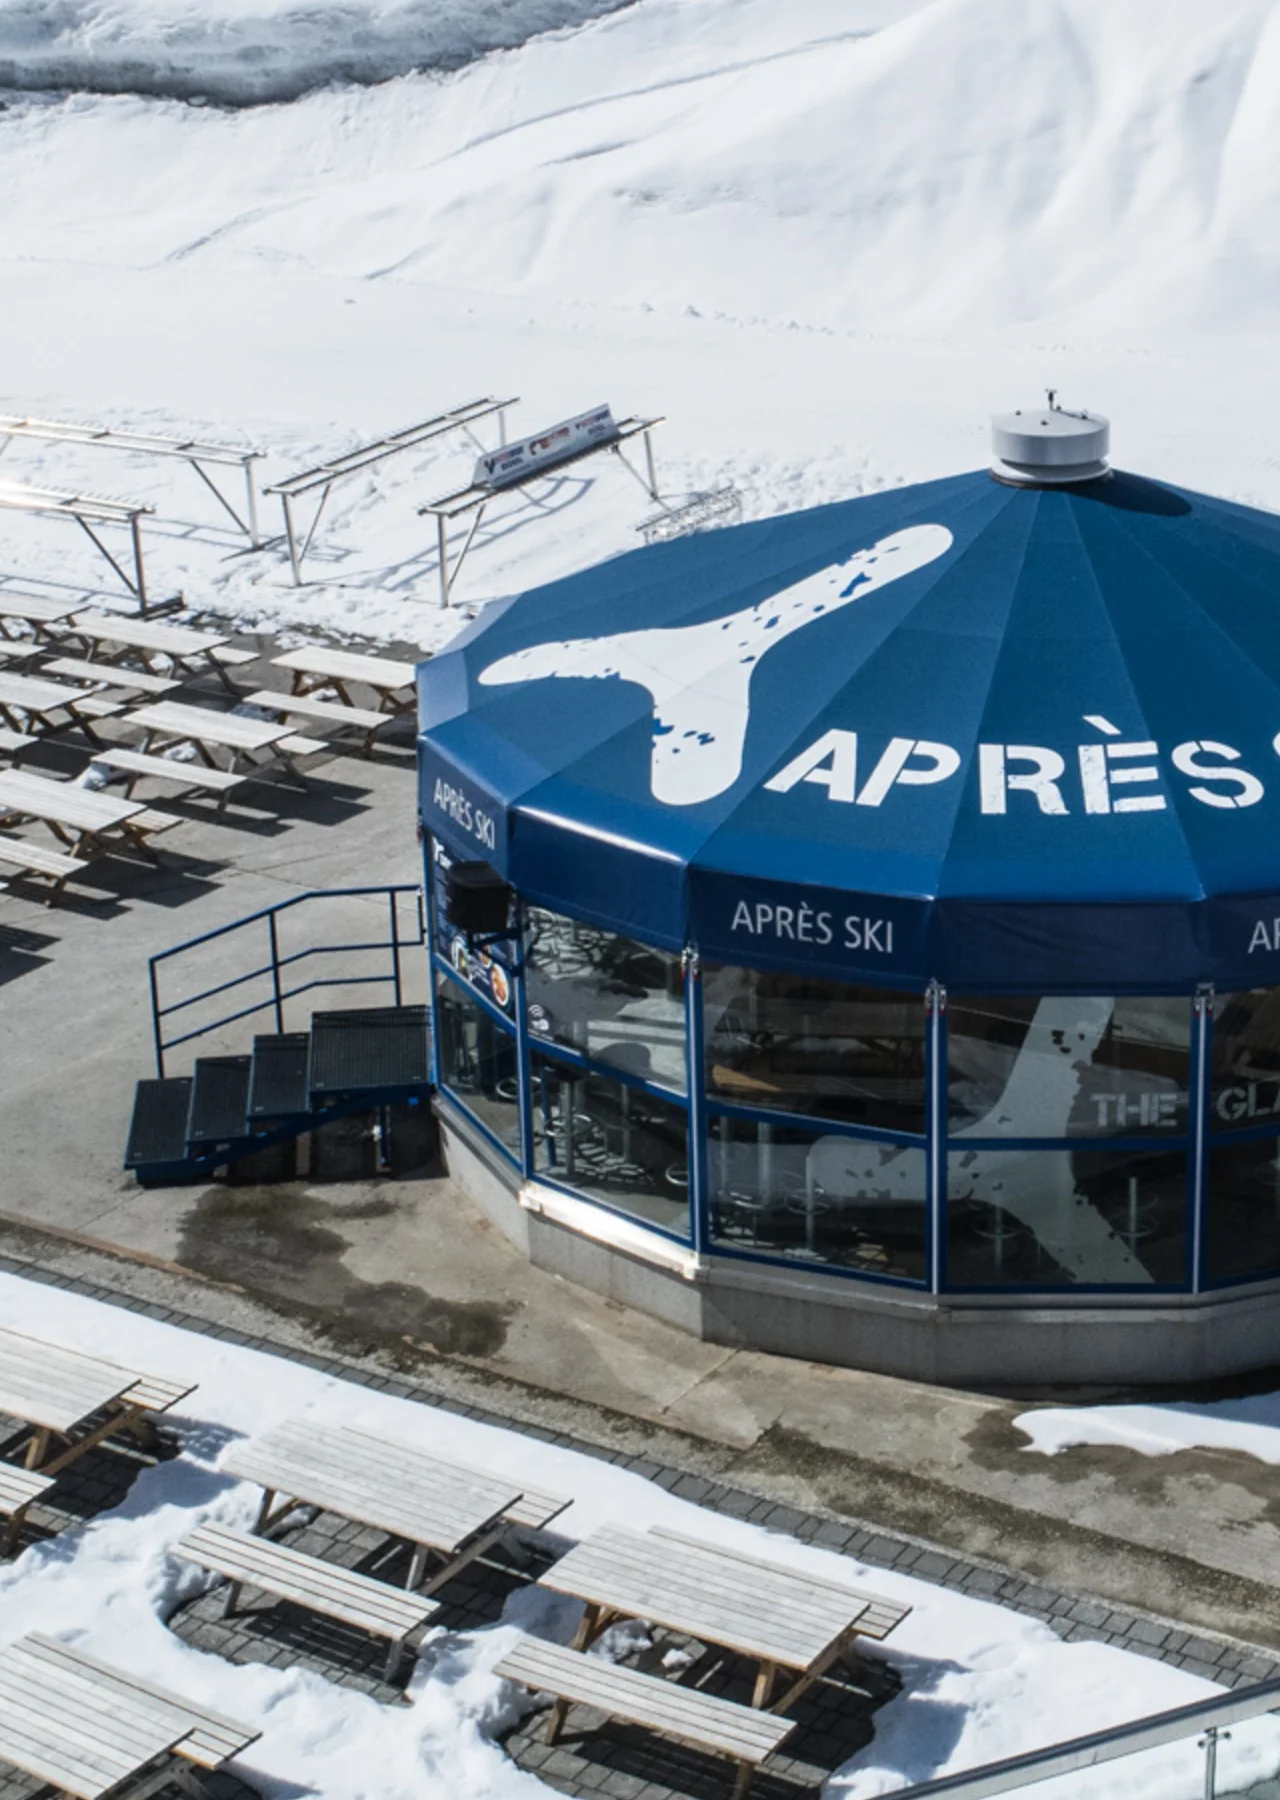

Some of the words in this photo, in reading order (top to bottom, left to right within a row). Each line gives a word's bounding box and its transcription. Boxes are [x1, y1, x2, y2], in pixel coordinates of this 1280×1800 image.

[762, 715, 1265, 815] APRÈS
[433, 777, 472, 832] APRÈS
[475, 809, 495, 851] SKI
[730, 900, 833, 945] APRÈS
[843, 916, 893, 953] SKI
[1089, 1093, 1178, 1127] THE
